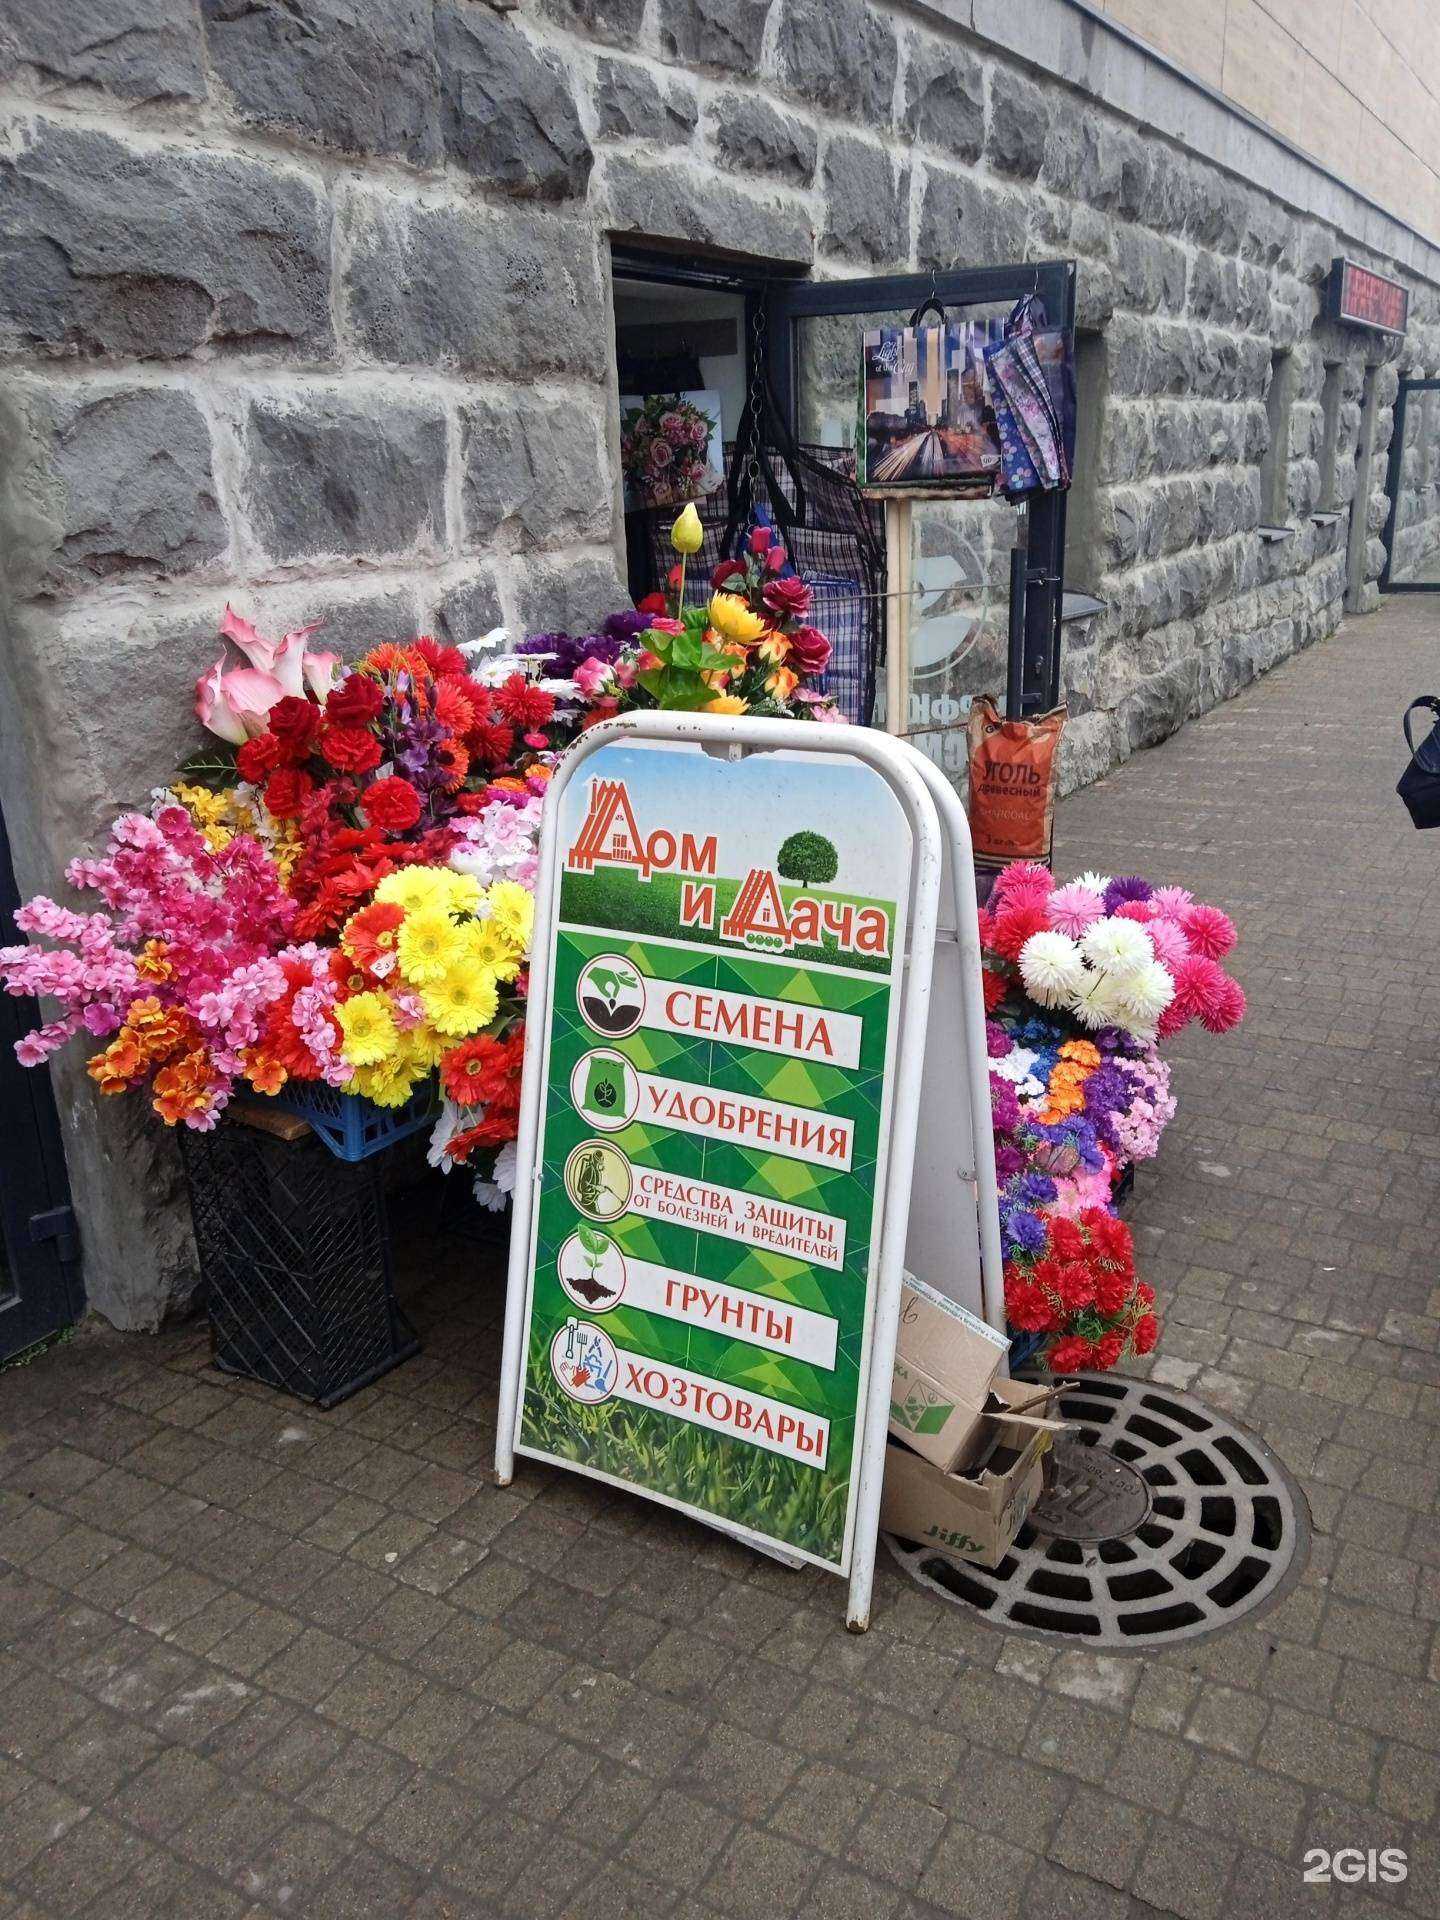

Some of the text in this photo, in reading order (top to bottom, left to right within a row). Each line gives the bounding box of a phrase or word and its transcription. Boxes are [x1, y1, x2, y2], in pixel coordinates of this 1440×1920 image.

[983, 761, 1041, 785] УГОЛЬ
[568, 776, 718, 879] Дом
[723, 870, 890, 953] Дача
[665, 990, 834, 1057] СЕМЕНА
[648, 1085, 849, 1160] УДОБРЕНИЯ
[633, 1194, 839, 1262] ОТ БОЛЕЗНЕЙ И ВРЕДИТЕЛЕЙ
[640, 1175, 834, 1243] СРЕДСТВА ЗАЩИТЫ
[665, 1279, 793, 1345] ГРУНТЫ
[625, 1362, 824, 1458] ХОЗТОВАРЫ
[922, 1525, 986, 1552] Jiffy
